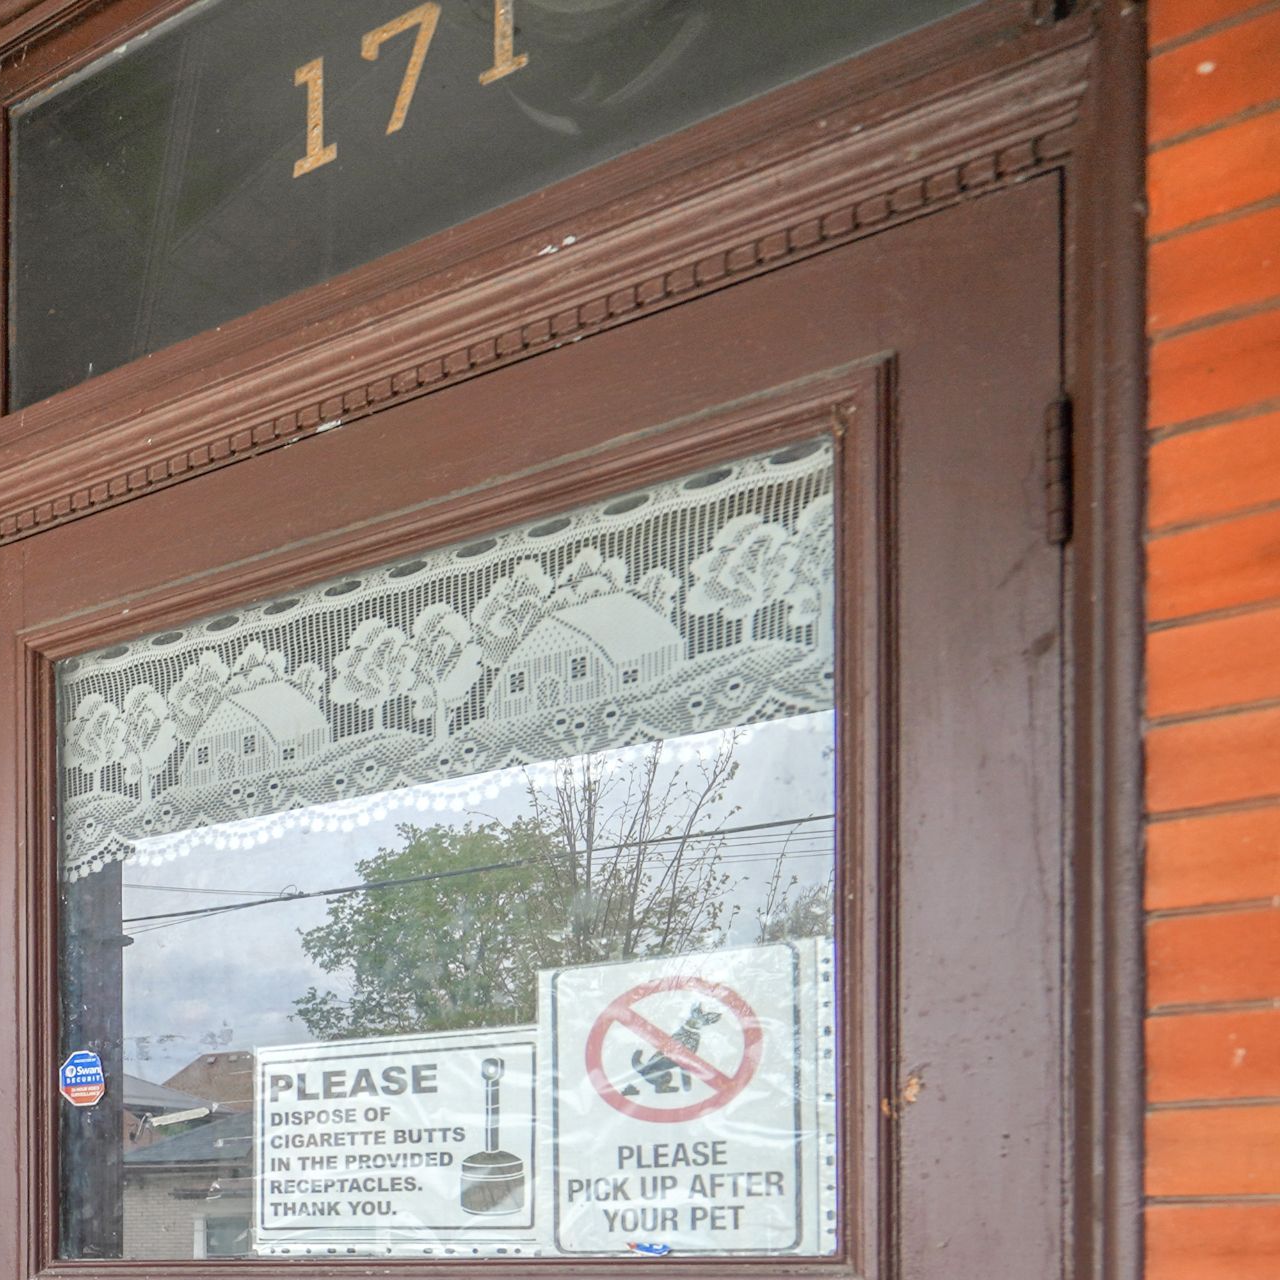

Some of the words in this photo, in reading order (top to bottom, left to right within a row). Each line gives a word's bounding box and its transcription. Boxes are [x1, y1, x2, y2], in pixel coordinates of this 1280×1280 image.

[293, 0, 528, 178] 171
[269, 1064, 438, 1102] PLEASE
[270, 1108, 357, 1127] DISPOSE
[363, 1106, 391, 1122] OF
[270, 1130, 386, 1149] CIGARETTE
[393, 1127, 466, 1145] BUTTS
[270, 1157, 290, 1172] IN
[298, 1155, 338, 1171] THE
[345, 1152, 453, 1170] PROVIDED
[617, 1140, 728, 1170] PLEASE
[270, 1177, 423, 1195] RECEPTACLES.
[568, 1177, 631, 1203] PICK
[640, 1175, 678, 1200] UP
[688, 1171, 785, 1199] AFTER
[270, 1202, 341, 1217] THANK
[348, 1201, 397, 1216] YOU.
[602, 1206, 679, 1233] YOUR
[690, 1205, 745, 1231] PET
